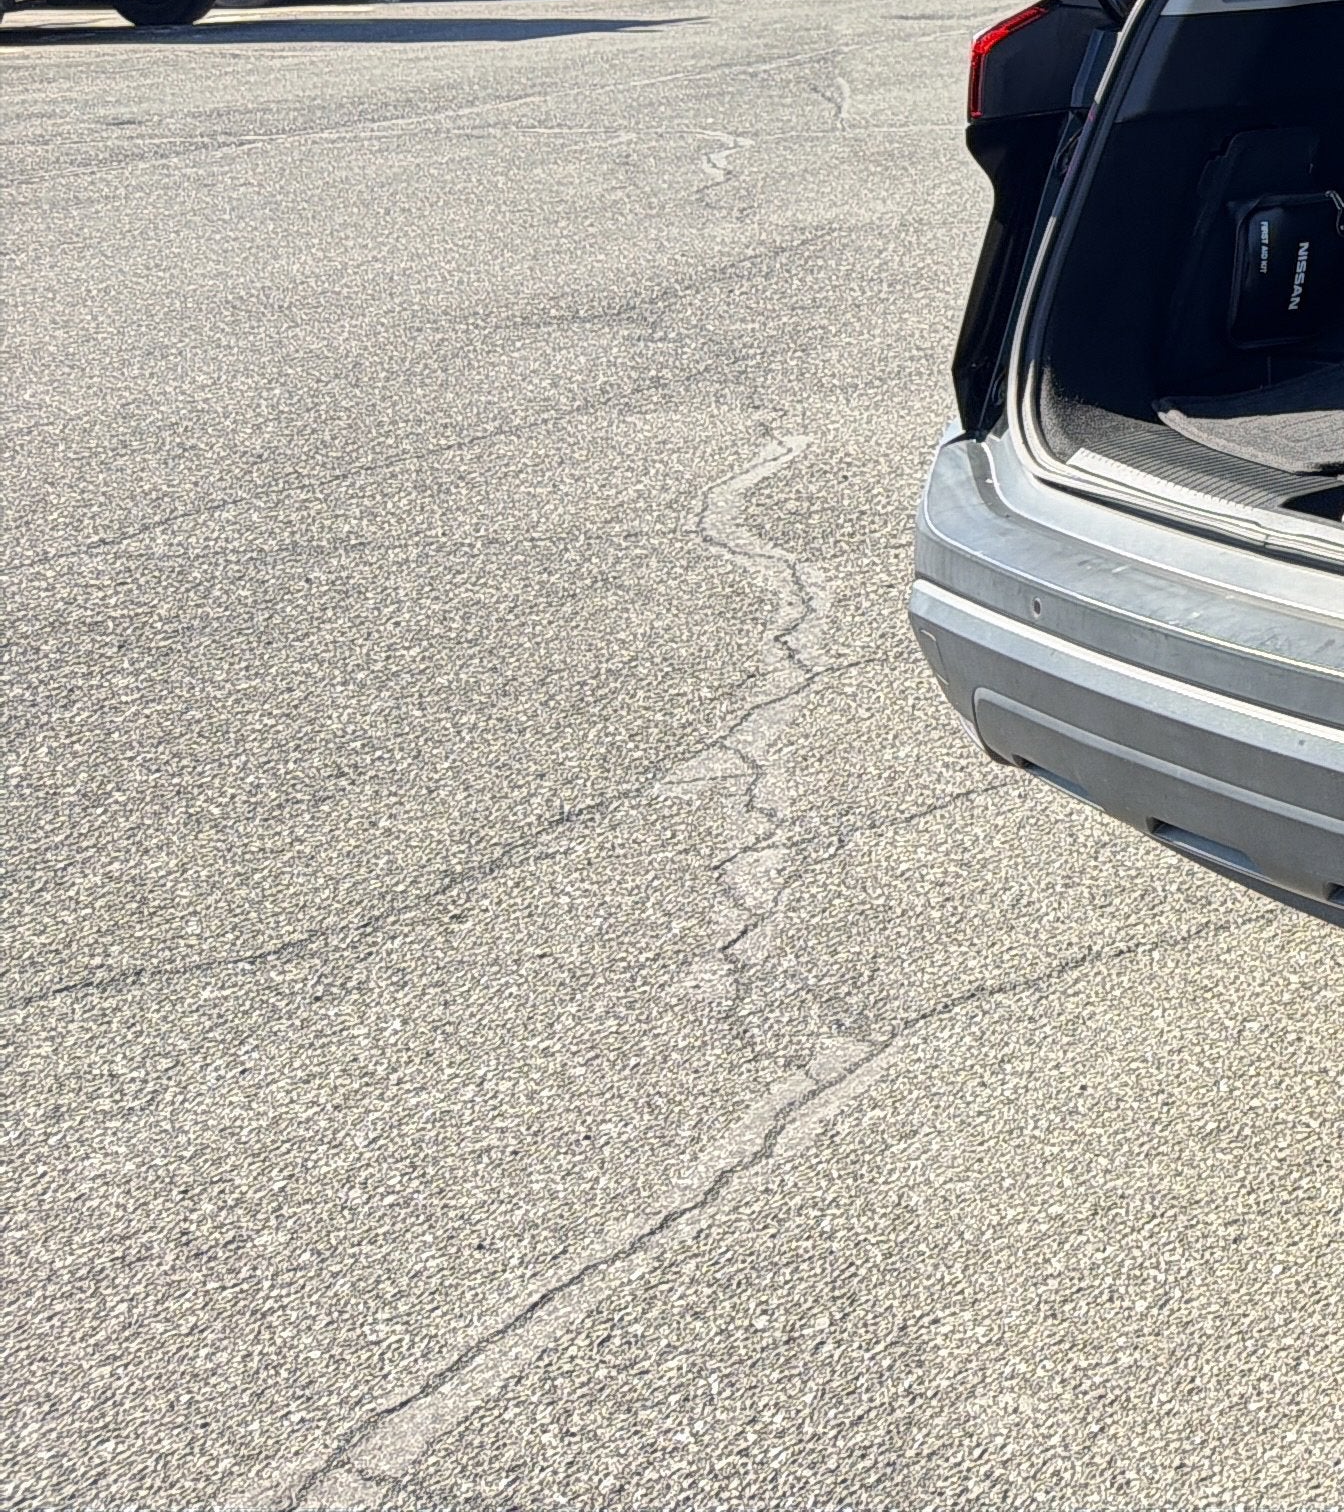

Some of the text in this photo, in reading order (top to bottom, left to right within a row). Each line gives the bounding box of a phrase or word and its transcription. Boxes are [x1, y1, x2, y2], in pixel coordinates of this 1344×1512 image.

[1260, 221, 1269, 244] FIRST
[1261, 245, 1269, 260] AID
[1288, 242, 1310, 310] NISSAN
